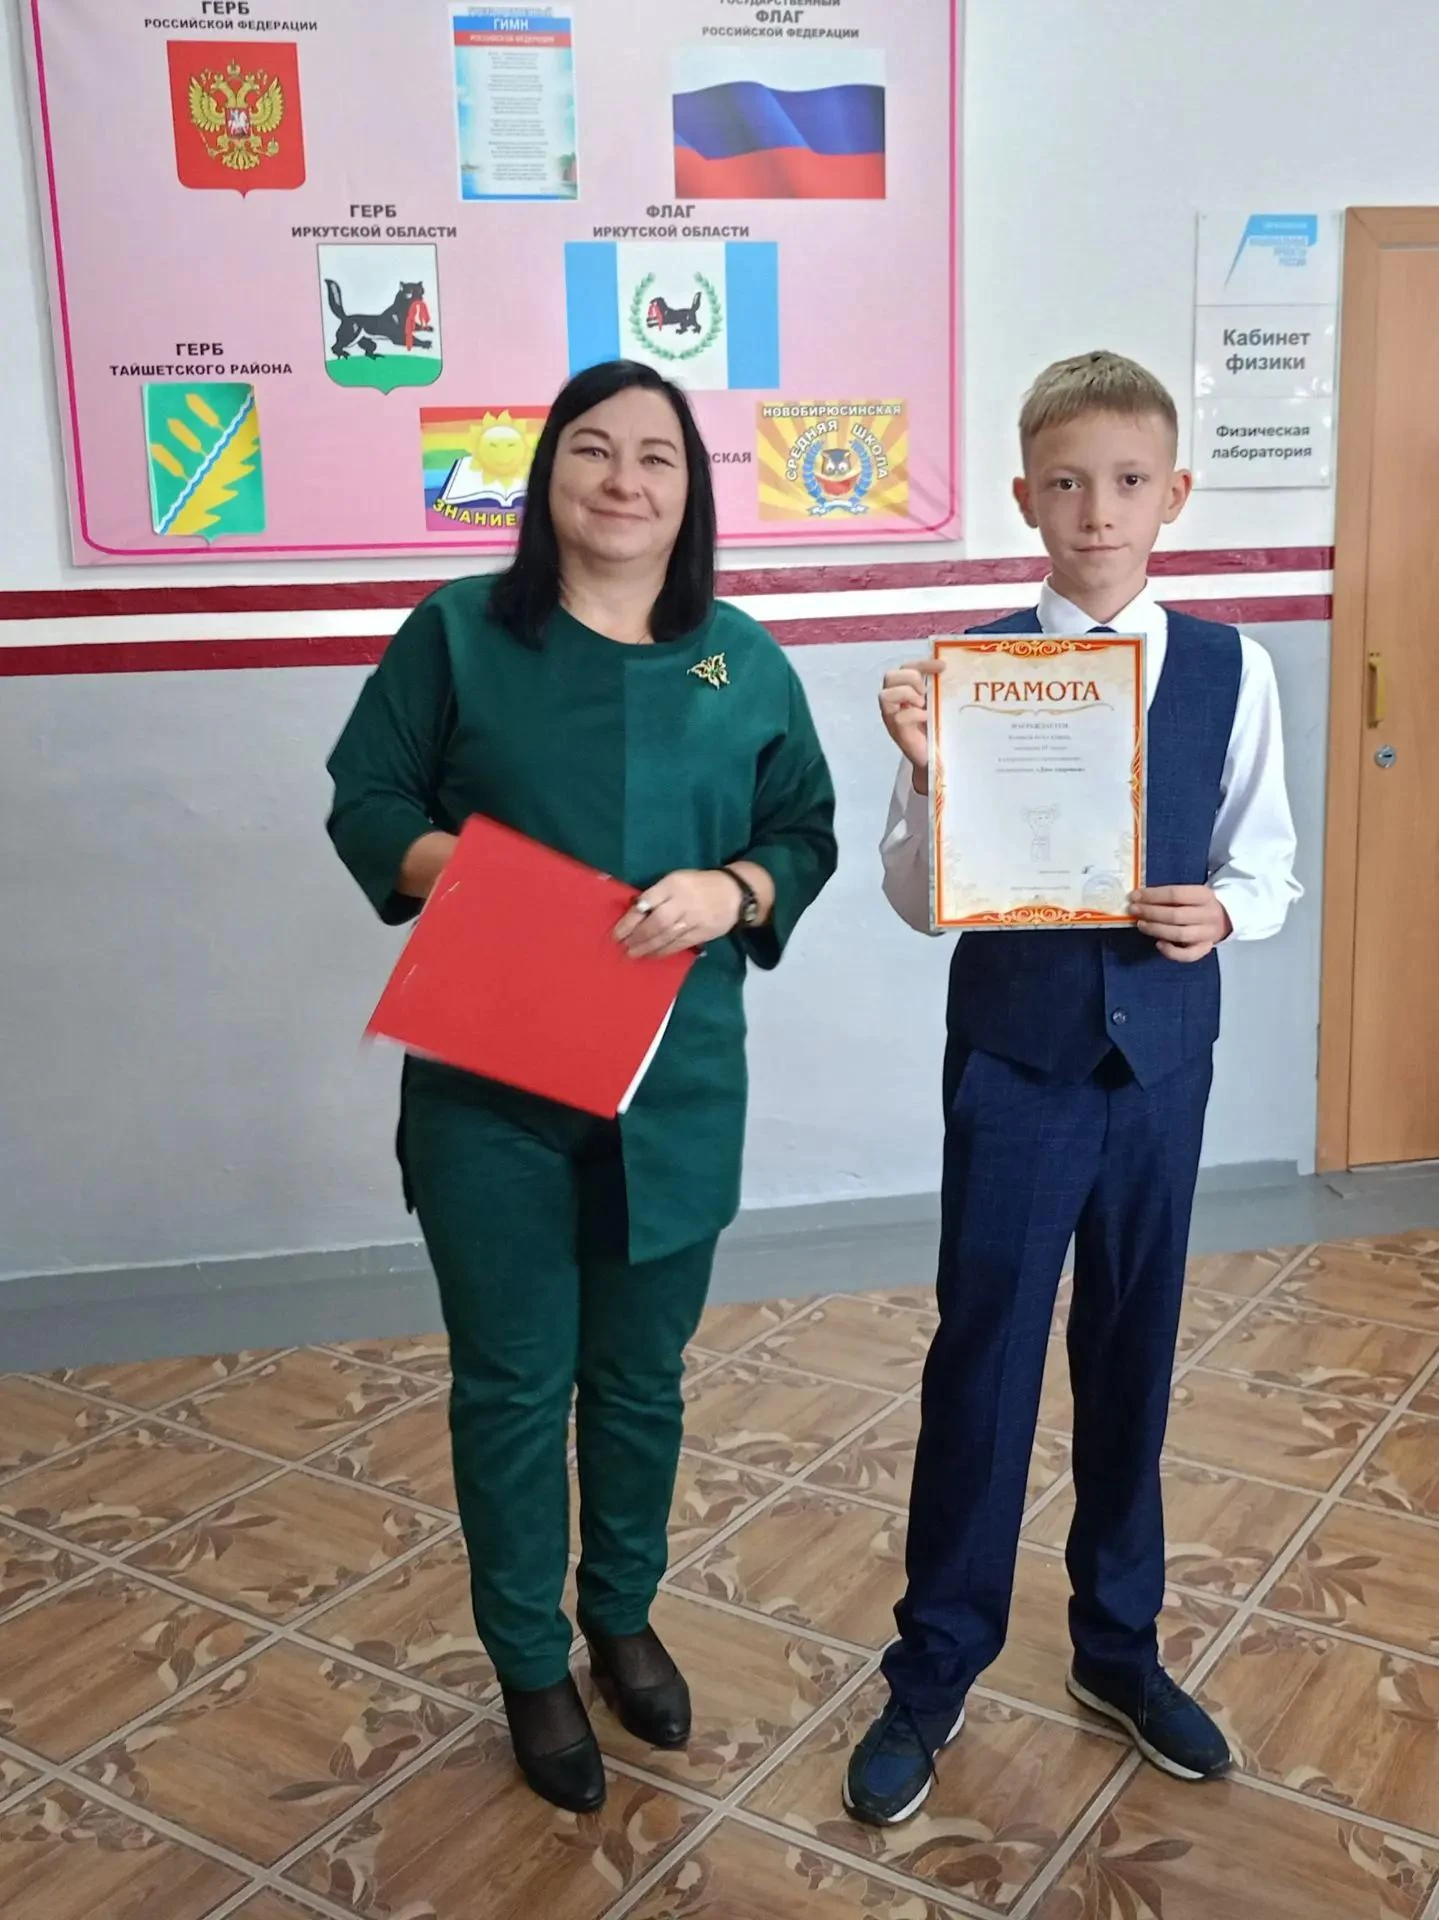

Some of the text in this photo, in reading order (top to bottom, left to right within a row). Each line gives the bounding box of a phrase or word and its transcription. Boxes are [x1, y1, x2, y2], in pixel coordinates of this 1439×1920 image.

[201, 1, 250, 14] ГЕРБ
[755, 10, 804, 23] ФЛАГ
[144, 18, 318, 31] РОССИЙСКОЙ ФЕДЕРАЦИИ
[493, 18, 529, 30] ГИМН
[702, 26, 859, 39] РОССИЙСКОЙ ФЕДЕРАЦИИ
[350, 204, 397, 218] ГЕРБ
[646, 205, 695, 218] ФЛАГ
[291, 225, 457, 238] ИРКУТСКОЙ ОБЛАСТИ
[593, 225, 749, 237] ИРКУТСКОЙ ОБЛАСТИ
[1223, 328, 1311, 347] Кабинет
[176, 343, 224, 356] ГЕРБ
[109, 362, 293, 376] ТАЙШЕТСКОГО РАЙОНА
[1225, 353, 1306, 374] физики
[763, 404, 901, 417] НОВОБИРЮСИНСКАЯ
[1216, 424, 1310, 438] Физическая
[785, 419, 889, 481] СРЕДНЯЯ ШКОЛА
[1211, 445, 1312, 460] лаборатория
[711, 452, 751, 463] СКАЯ
[432, 498, 518, 527] ЗНАНИЕ
[973, 680, 1101, 702] ГРАМОТА
